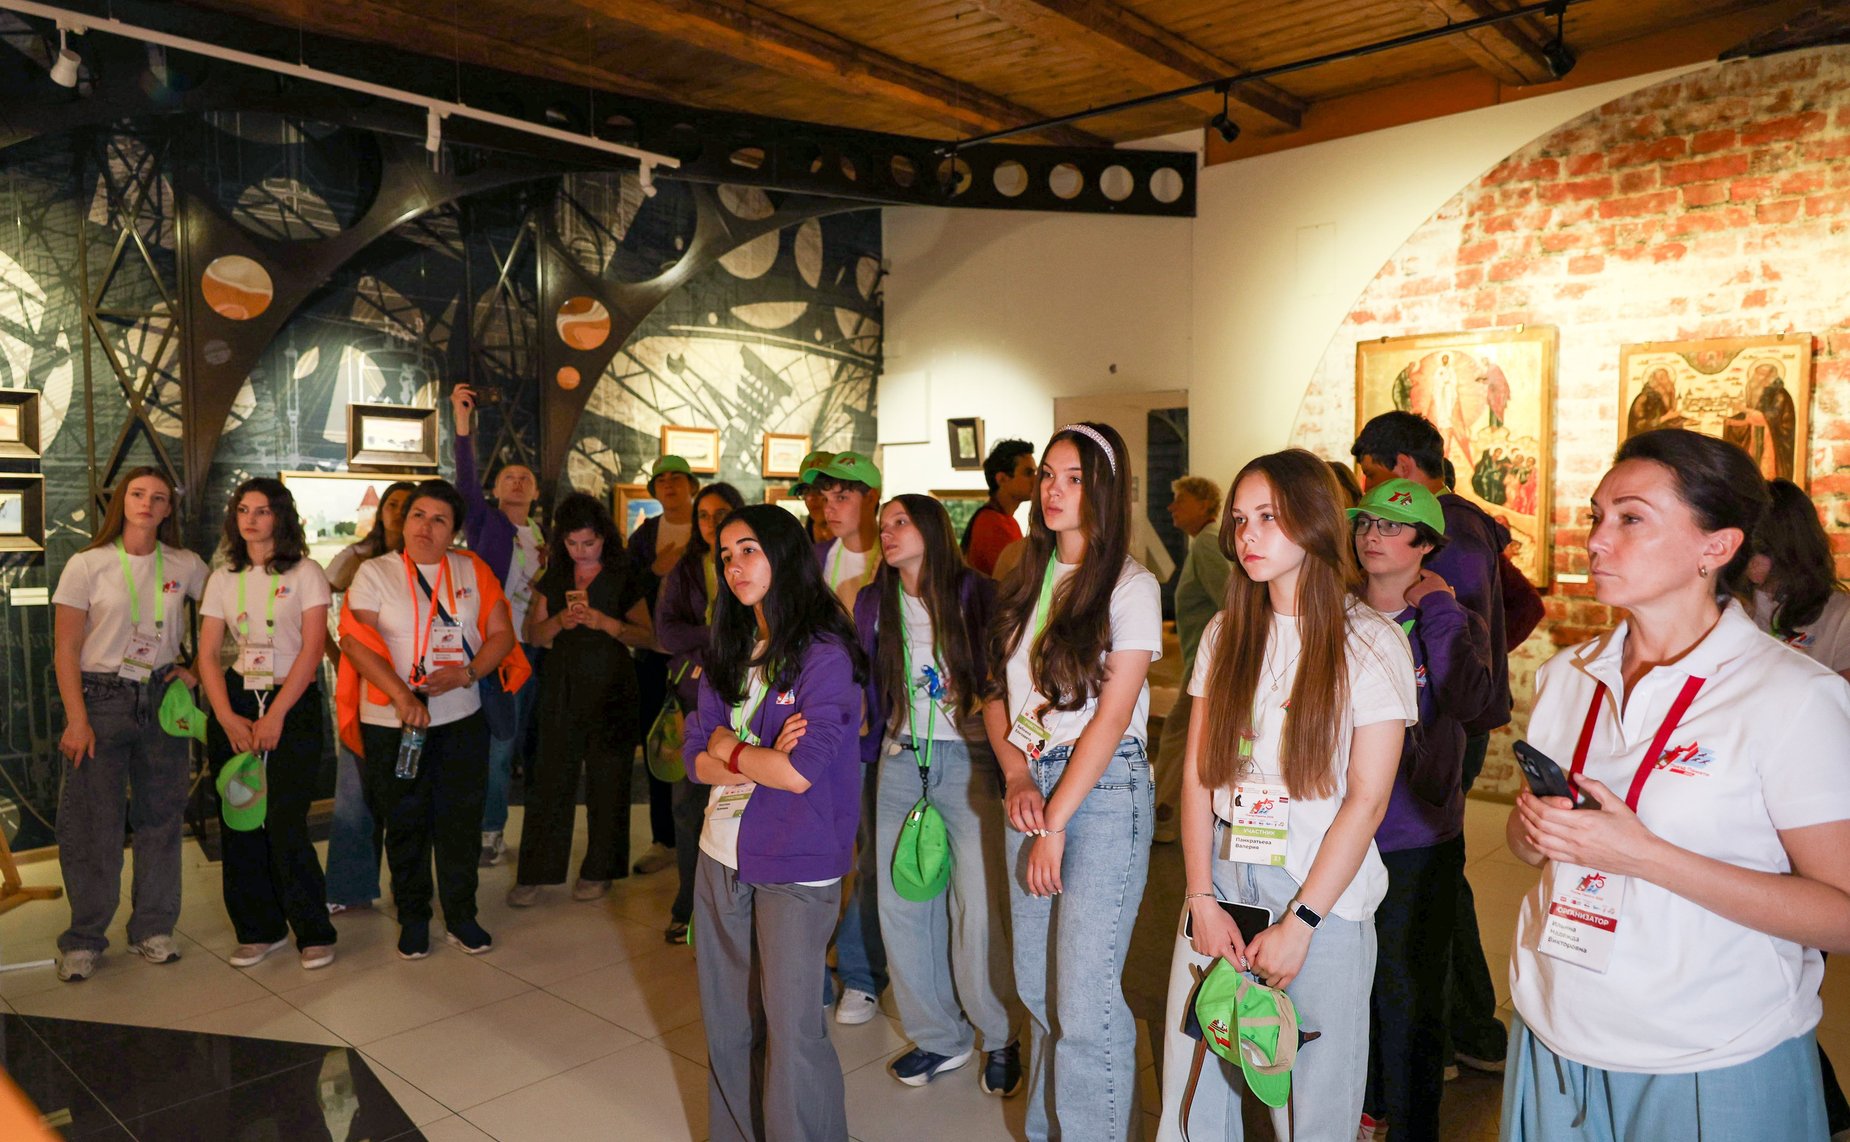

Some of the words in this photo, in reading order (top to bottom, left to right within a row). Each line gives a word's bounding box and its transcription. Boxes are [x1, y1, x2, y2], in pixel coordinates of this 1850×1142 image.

[1243, 828, 1276, 836] УЧАСТНИК
[1235, 837, 1272, 845] Панкратьева
[1557, 906, 1610, 926] ОРГАНИЗАТОР
[1547, 936, 1588, 954] Викторовна
